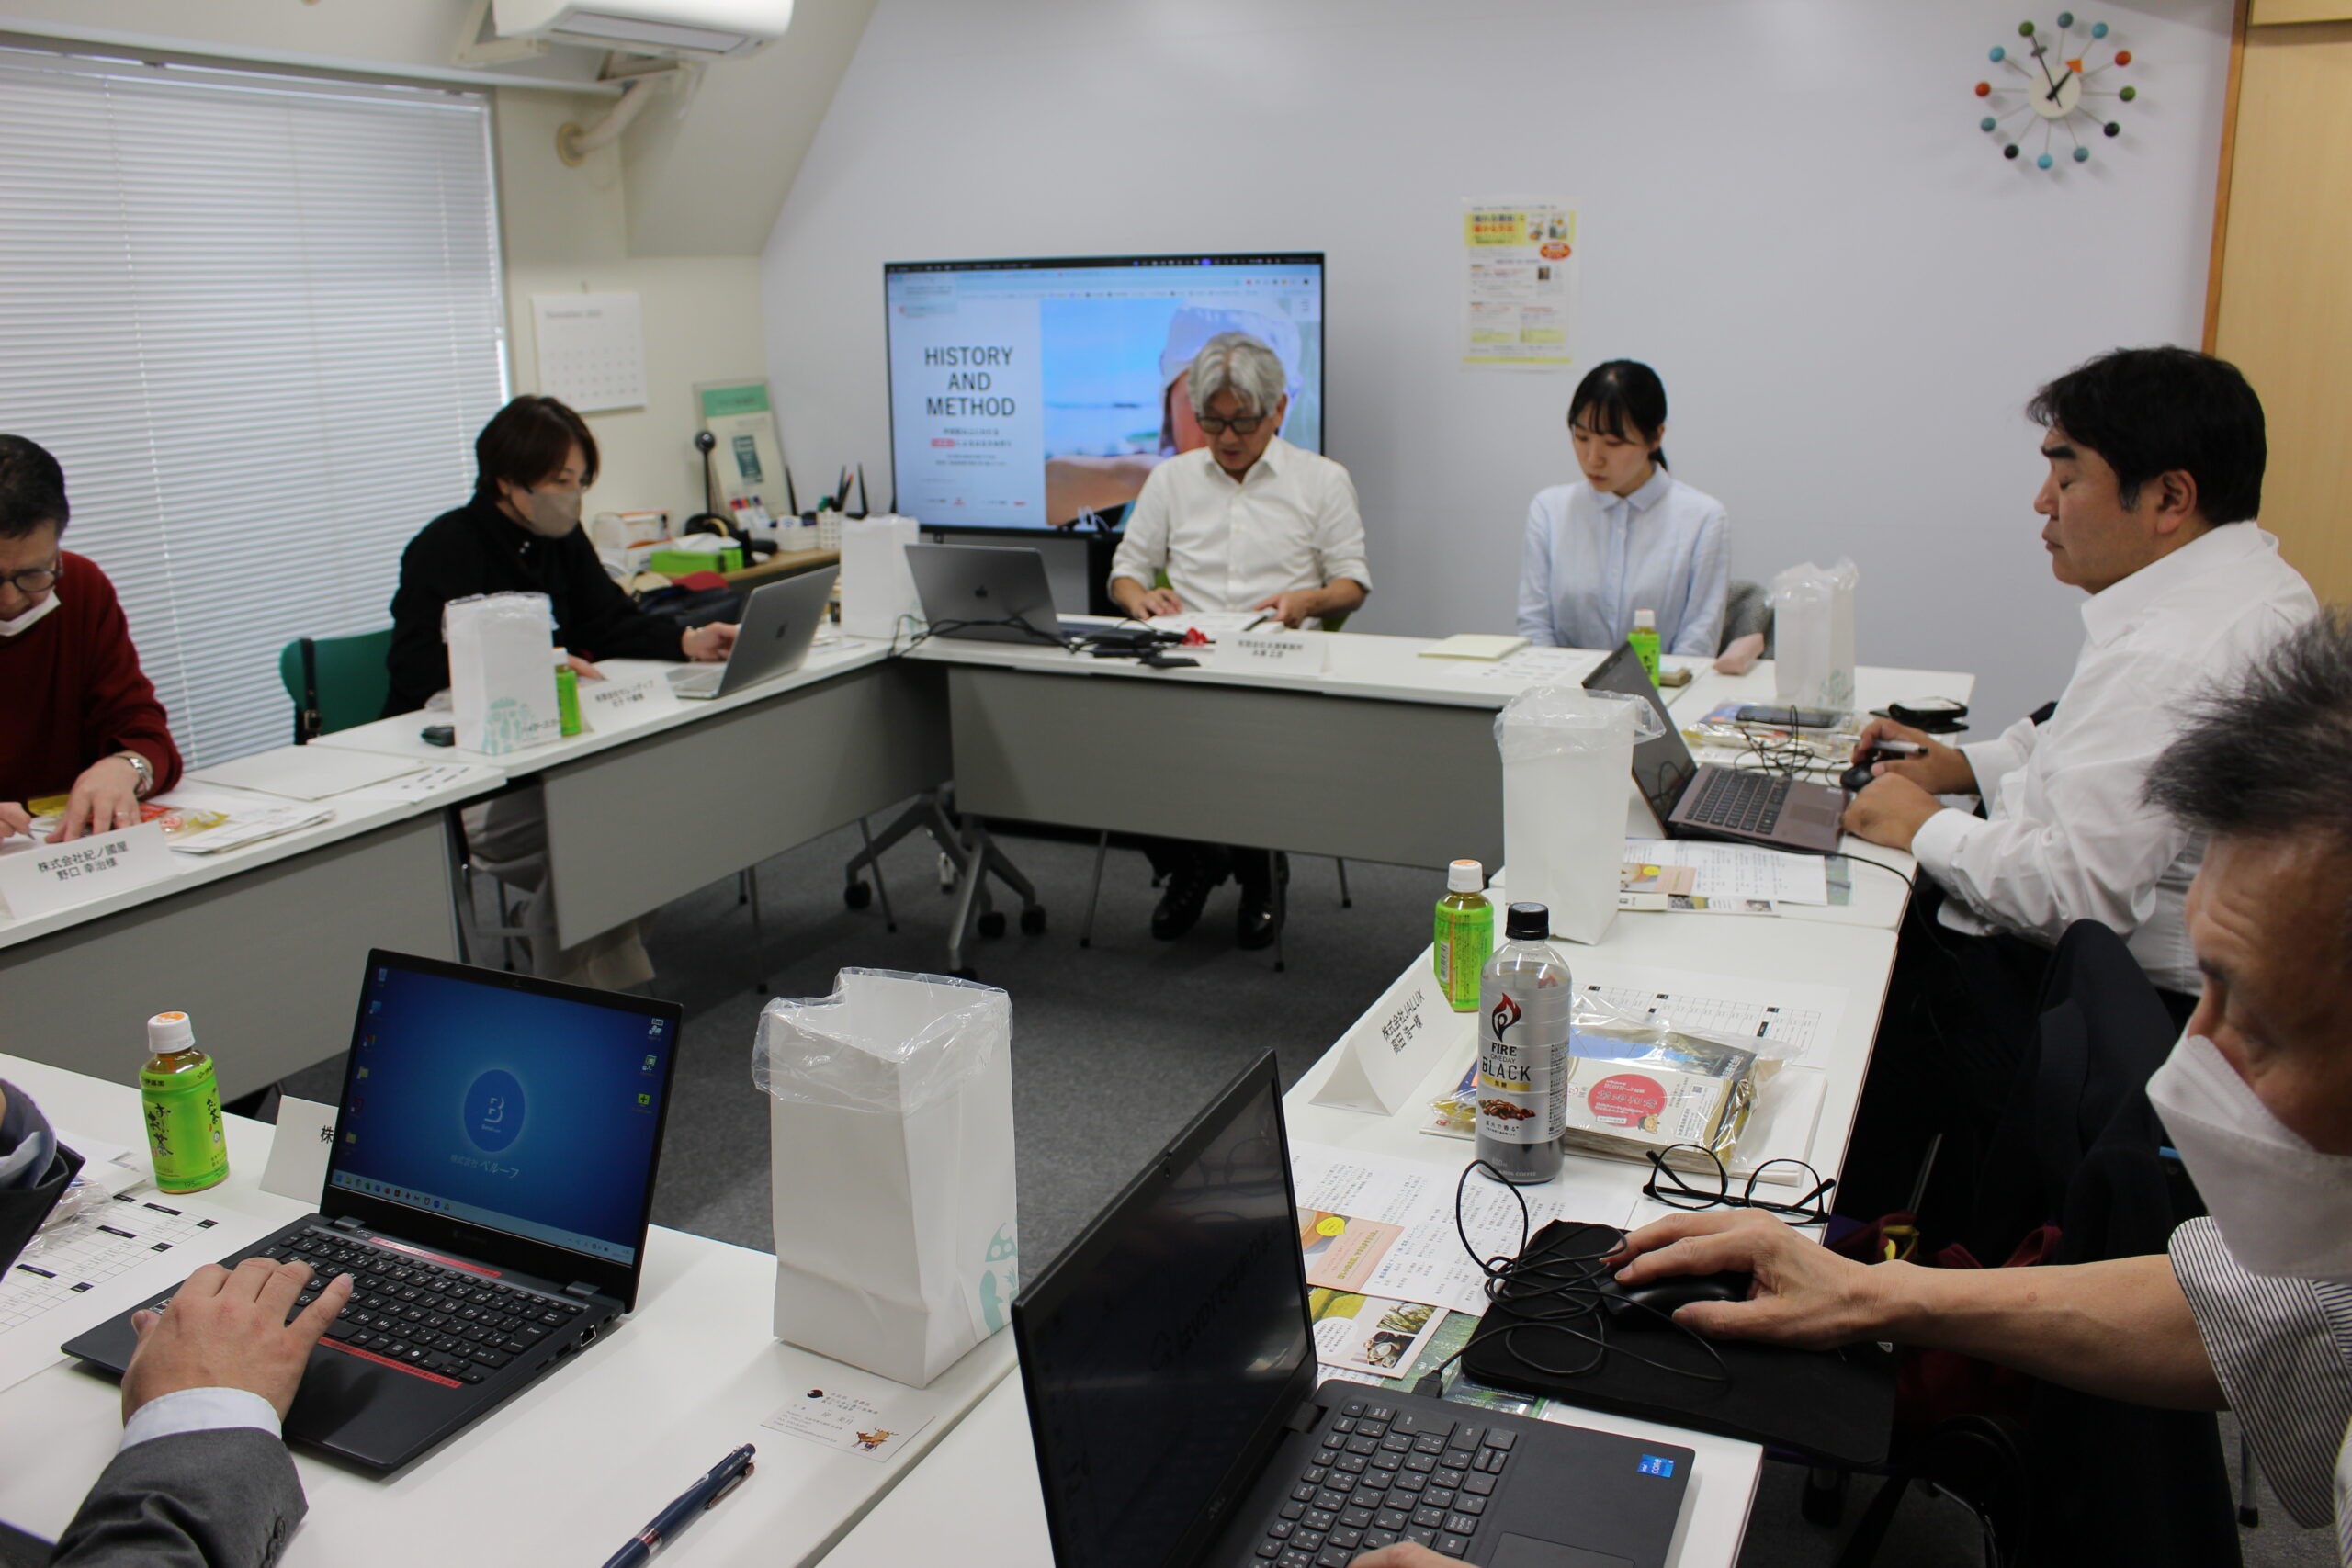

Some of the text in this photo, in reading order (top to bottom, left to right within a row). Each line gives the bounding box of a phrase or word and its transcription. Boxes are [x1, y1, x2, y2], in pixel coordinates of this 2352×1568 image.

[924, 345, 1013, 367] HISTORY
[947, 371, 991, 391] AND
[926, 397, 1015, 416] METHOD
[1490, 1054, 1516, 1065] ONEDAY
[1491, 1042, 1517, 1057] FIRE
[1481, 1056, 1531, 1082] BLACK
[320, 1124, 334, 1145] 株
